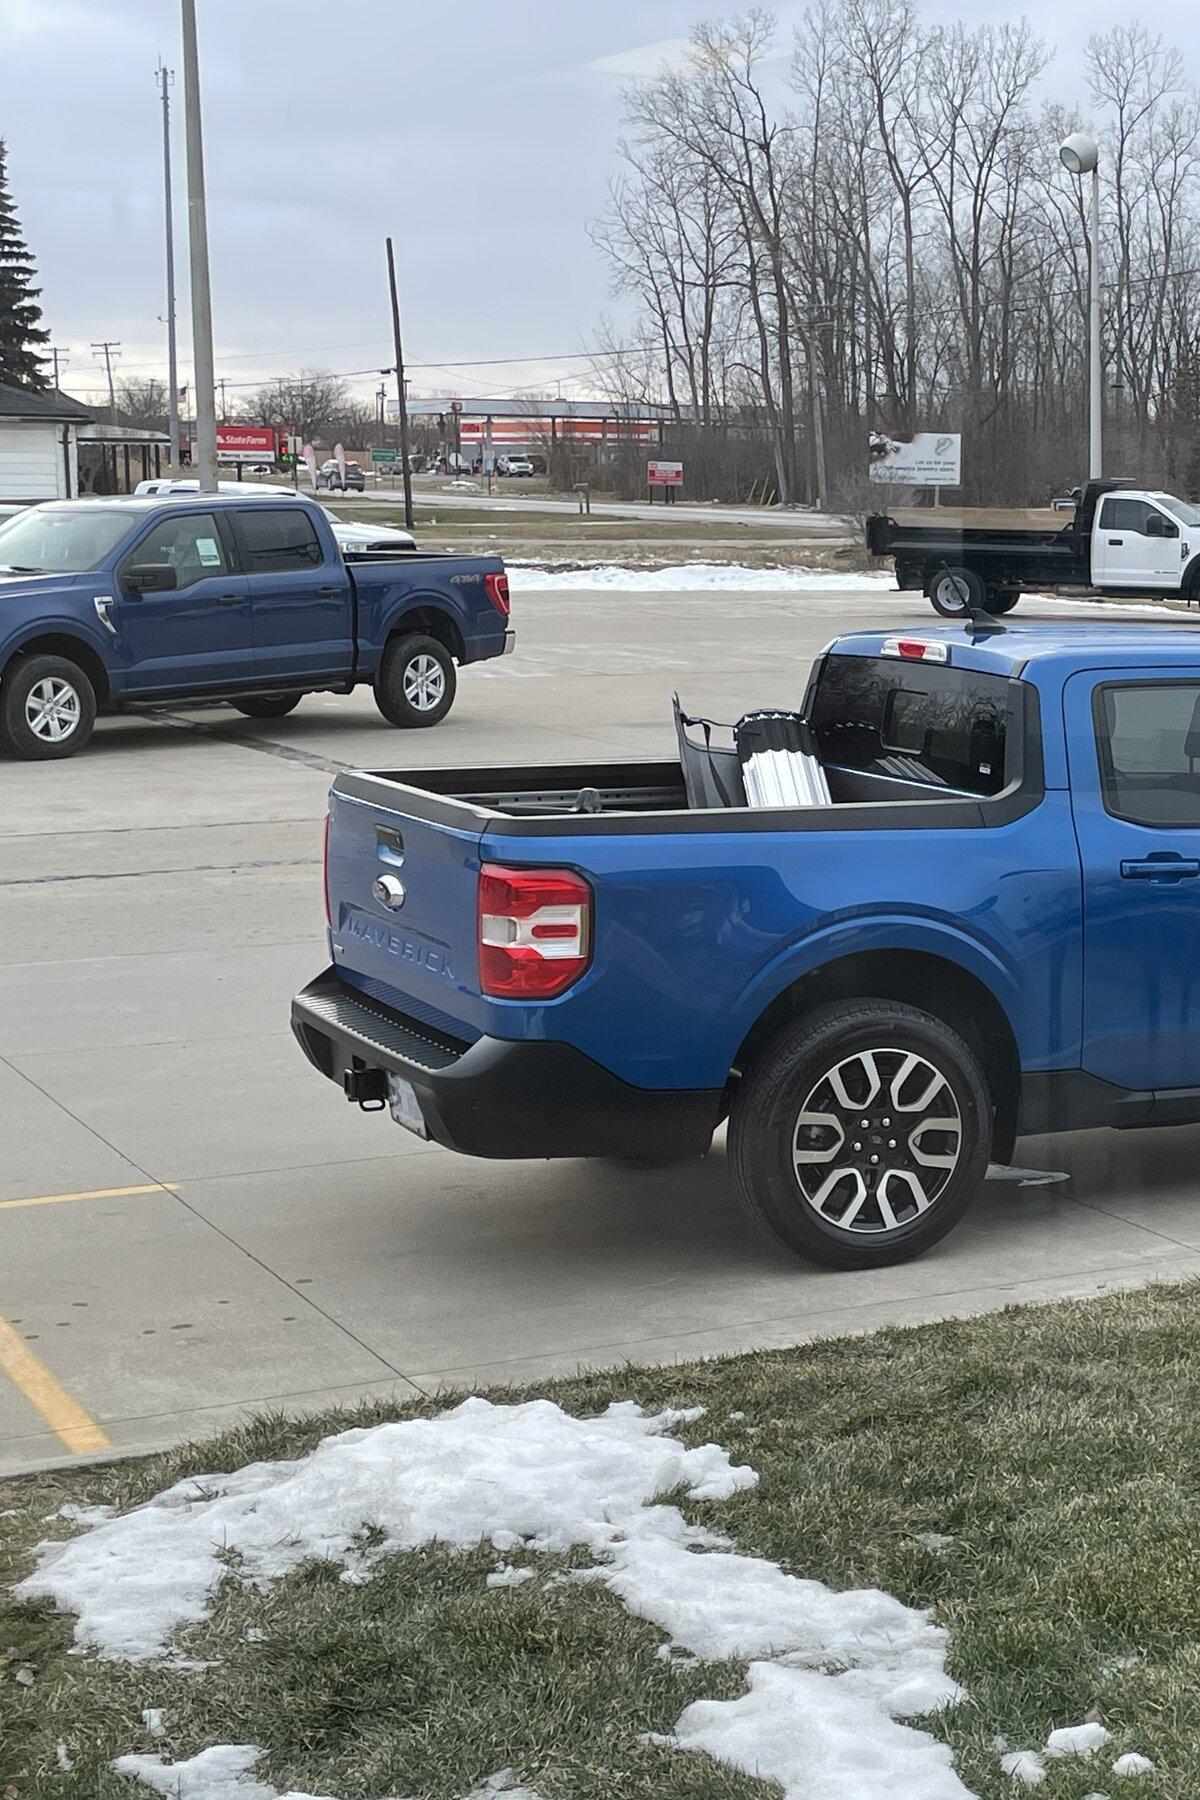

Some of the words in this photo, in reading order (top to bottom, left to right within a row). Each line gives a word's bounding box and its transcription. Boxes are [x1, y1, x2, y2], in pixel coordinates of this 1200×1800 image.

[225, 435, 246, 445] State
[246, 435, 267, 445] Farm
[347, 915, 455, 979] MAVERICK
